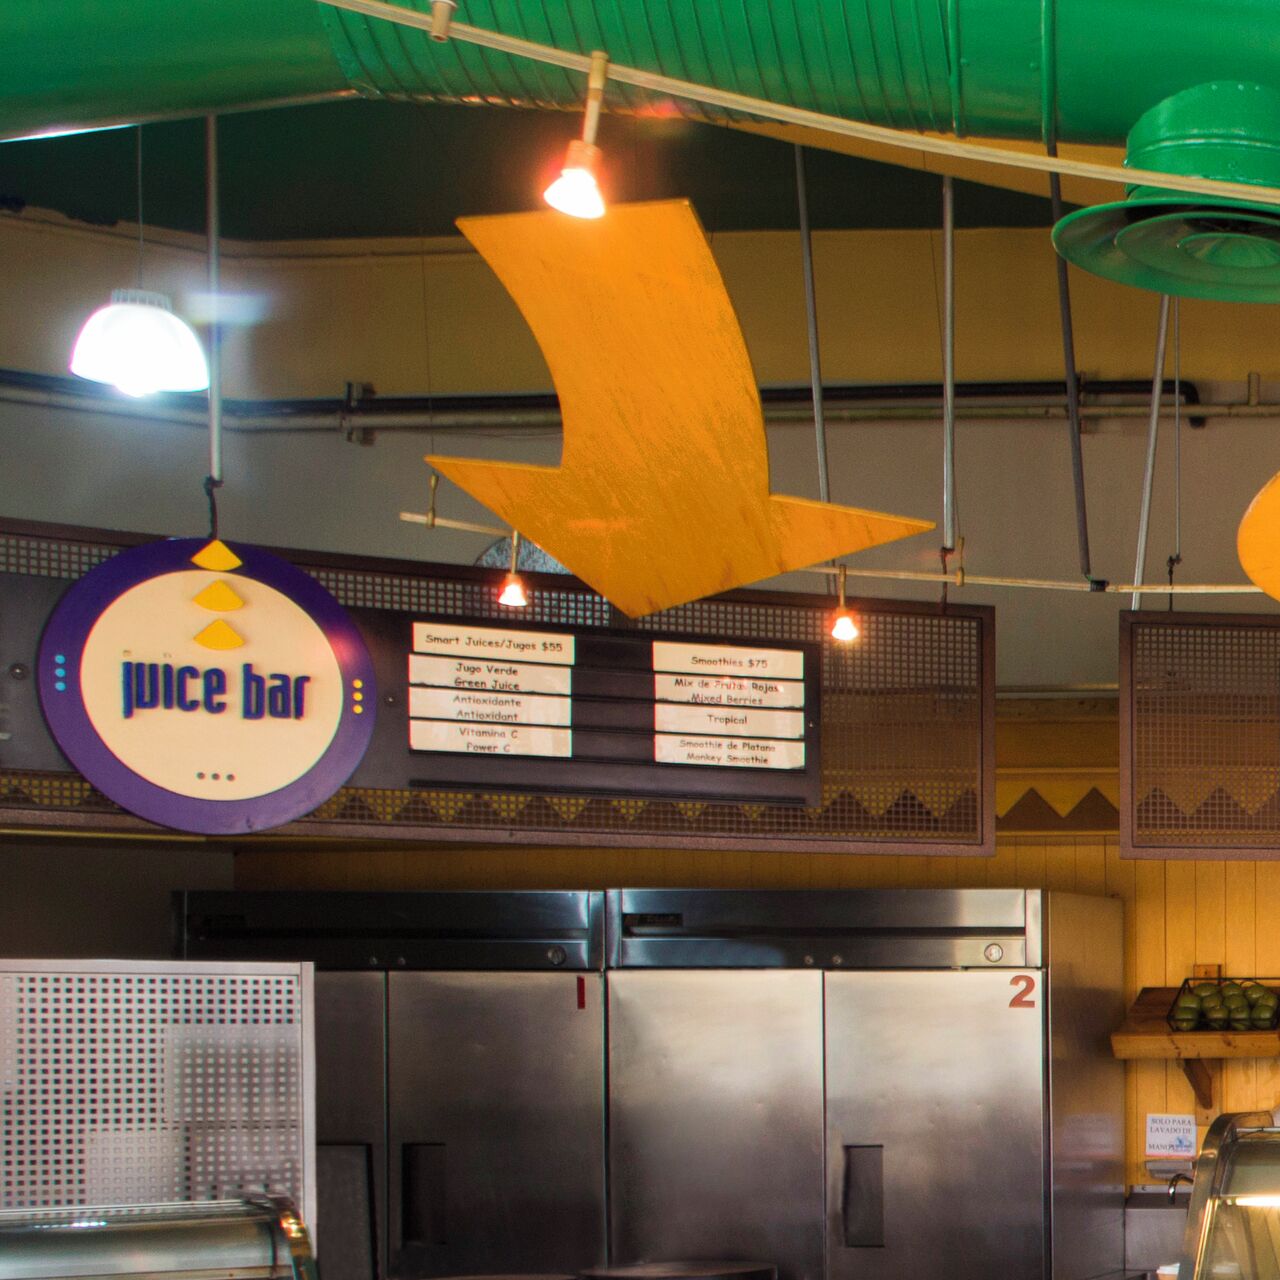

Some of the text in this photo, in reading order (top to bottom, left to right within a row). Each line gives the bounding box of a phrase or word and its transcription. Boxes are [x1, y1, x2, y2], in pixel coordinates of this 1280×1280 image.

[425, 634, 563, 652] Smart Juices/Jugos $55
[691, 656, 768, 669] Smoothies $75
[455, 663, 519, 676] Jugo Verde
[121, 660, 311, 720] juice bar
[454, 678, 520, 691] Green Juice
[674, 678, 693, 688] Mix
[697, 680, 710, 689] de
[751, 682, 779, 694] Rojas
[453, 695, 522, 707] Antioxidante
[691, 694, 763, 706] Mixed Berries
[456, 710, 519, 722] Antioxidant
[707, 714, 748, 726] Tropical
[459, 727, 519, 739] Vitamina C
[503, 744, 511, 753] C
[680, 739, 723, 749] Smoothie
[727, 741, 739, 750] de
[686, 753, 769, 765] Monkey Smoothie
[1009, 975, 1035, 1008] 2
